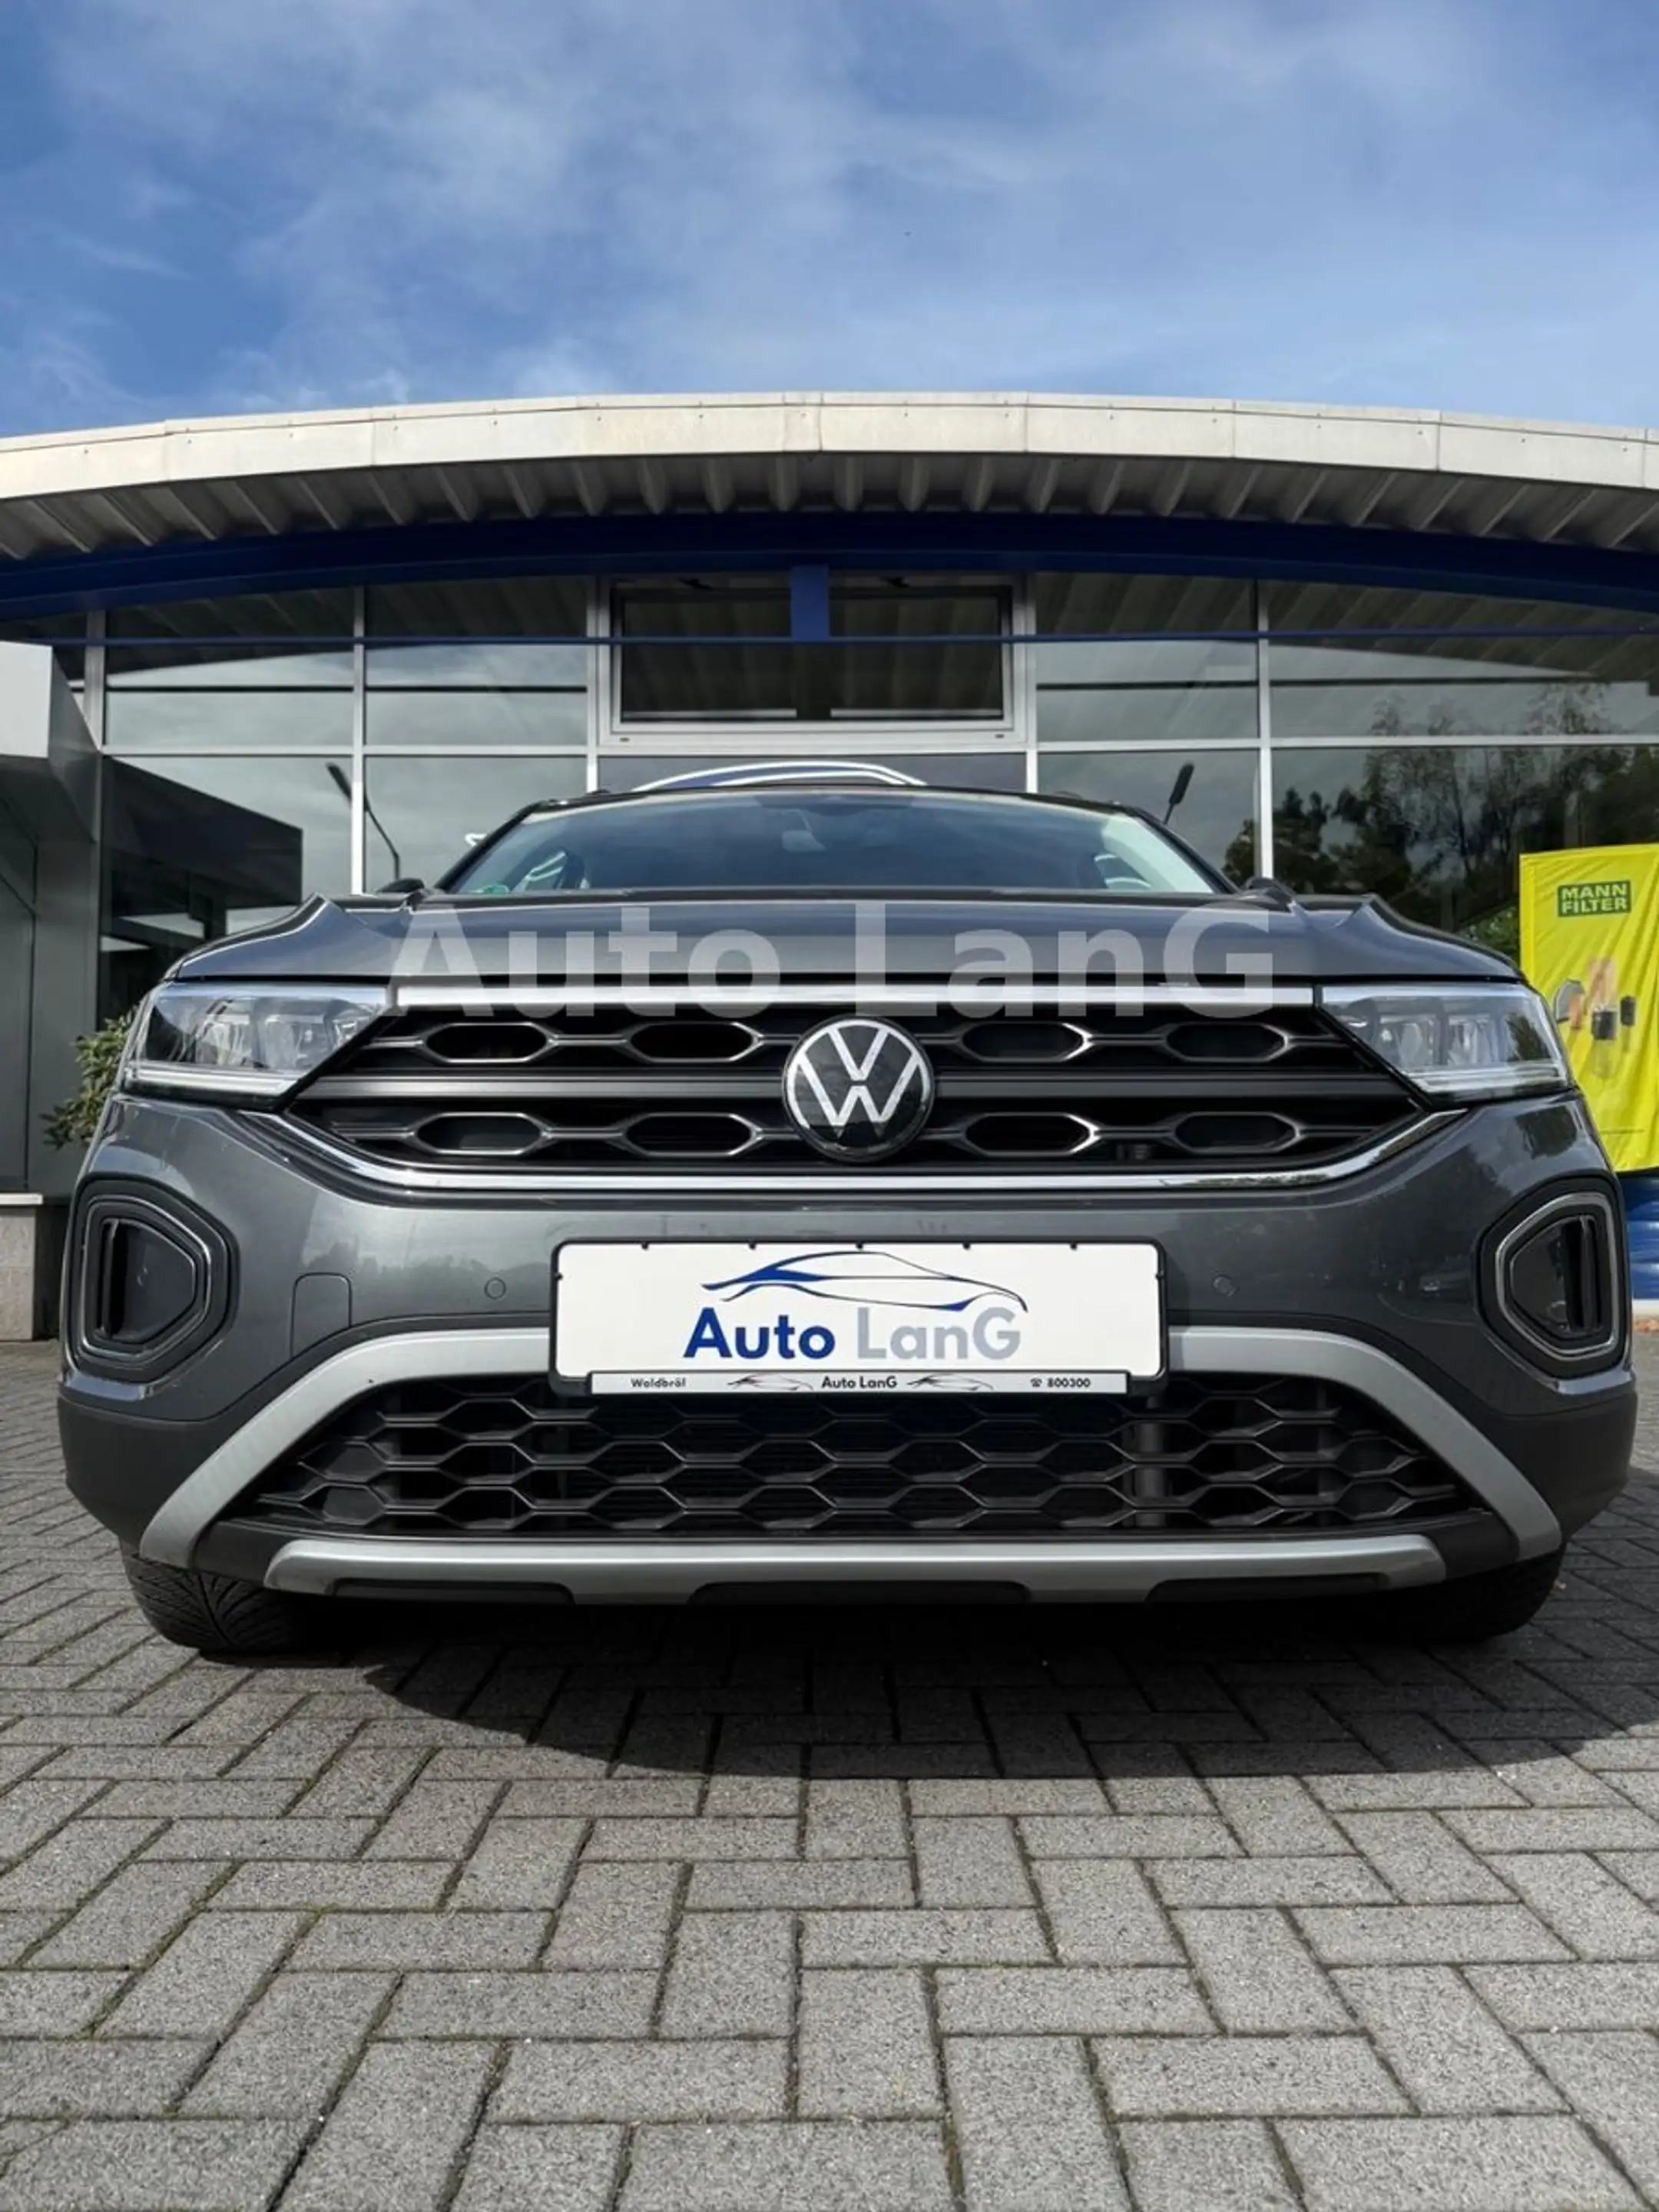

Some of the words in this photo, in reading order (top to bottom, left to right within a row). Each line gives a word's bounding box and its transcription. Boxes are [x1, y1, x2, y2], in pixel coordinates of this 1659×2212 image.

[1561, 883, 1627, 899] MANN
[1561, 897, 1627, 914] FILTER
[683, 1306, 836, 1359] Auto
[856, 1306, 1022, 1359] LanG
[821, 1376, 856, 1389] Auto
[859, 1376, 898, 1389] LanG
